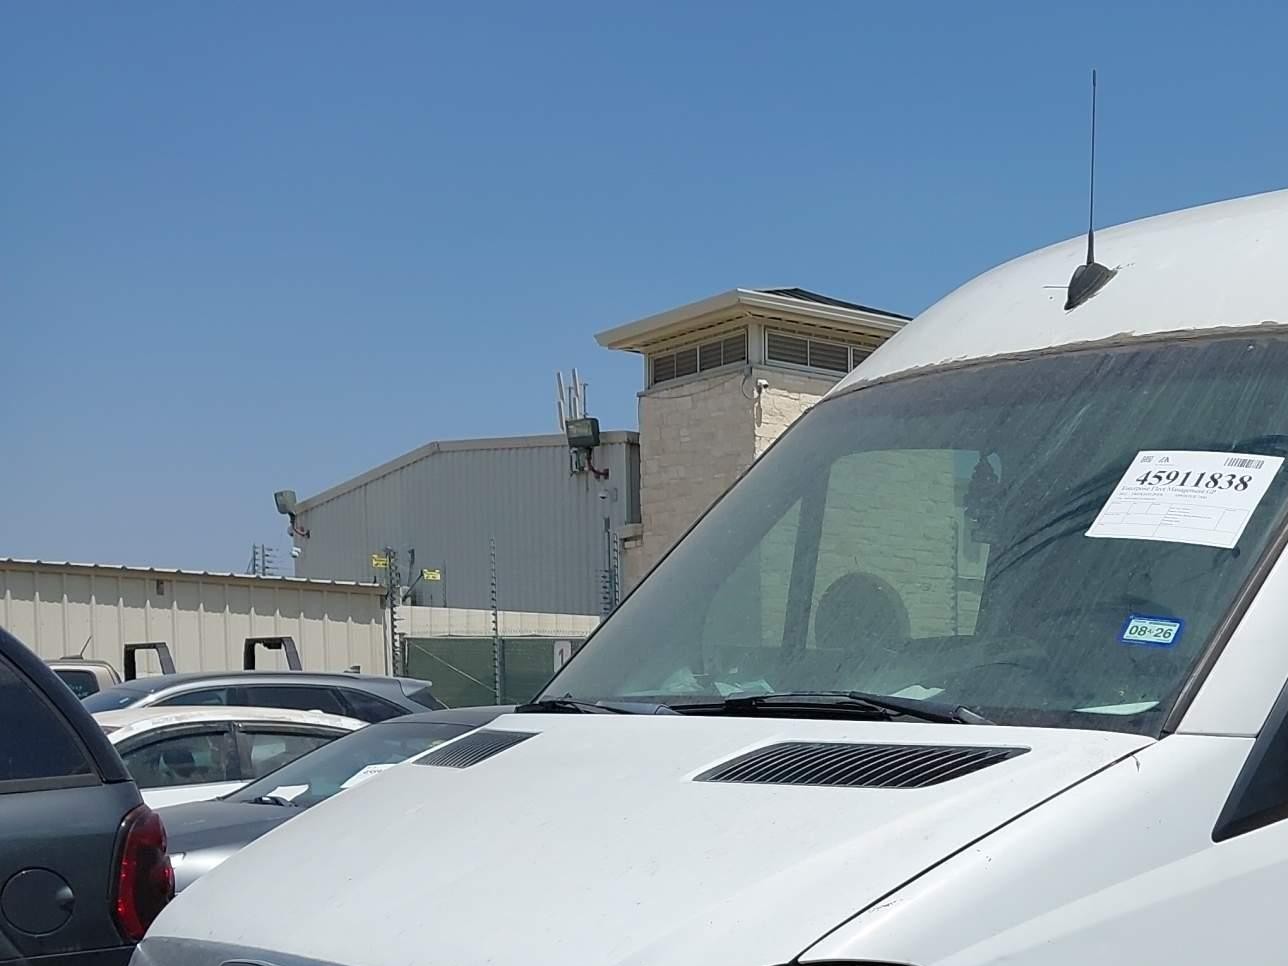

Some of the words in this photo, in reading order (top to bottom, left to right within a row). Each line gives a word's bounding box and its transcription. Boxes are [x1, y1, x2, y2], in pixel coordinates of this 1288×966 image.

[1136, 470, 1252, 492] 45911838
[1128, 625, 1148, 636] 08
[1153, 627, 1173, 639] 26
